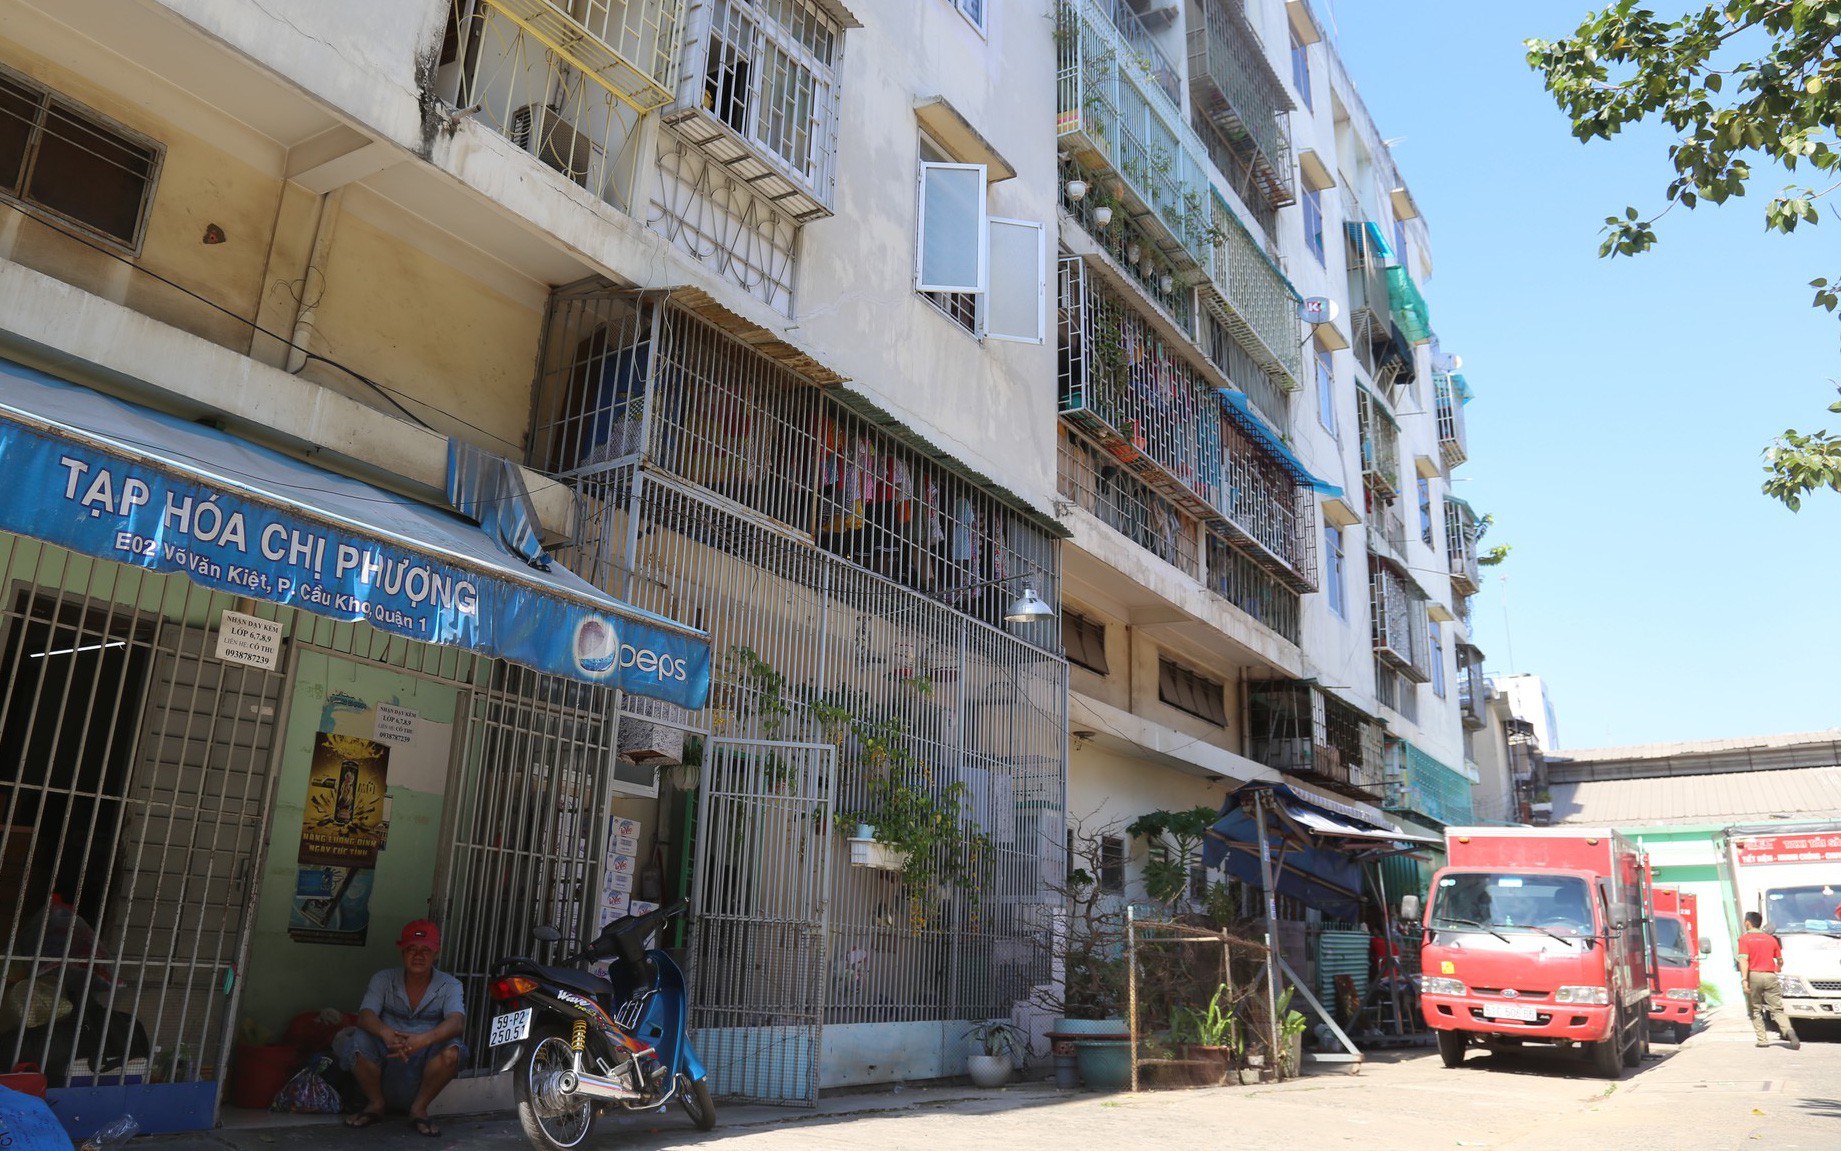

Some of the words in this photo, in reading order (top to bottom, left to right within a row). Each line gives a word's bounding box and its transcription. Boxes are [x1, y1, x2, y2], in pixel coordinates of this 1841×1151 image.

[61, 456, 151, 518] TẠP
[164, 490, 247, 553] HÓA
[261, 522, 327, 580] CHỊ
[334, 543, 478, 616] PHƯỢNG
[115, 531, 157, 557] E02
[163, 541, 187, 565] Võ
[189, 552, 221, 579] Văn
[227, 564, 272, 593] Kiệt,
[277, 577, 296, 596] P.
[300, 583, 331, 606] Cầu
[334, 592, 373, 619] Kho,
[374, 603, 414, 630] Quận
[419, 616, 426, 632] 1
[231, 626, 249, 637] LỚP
[225, 648, 270, 665] 0938787239
[379, 731, 411, 743] 0938787239
[556, 989, 591, 1006] Wave
[496, 1010, 526, 1030] 59-P2
[490, 1024, 526, 1046] 250.51
